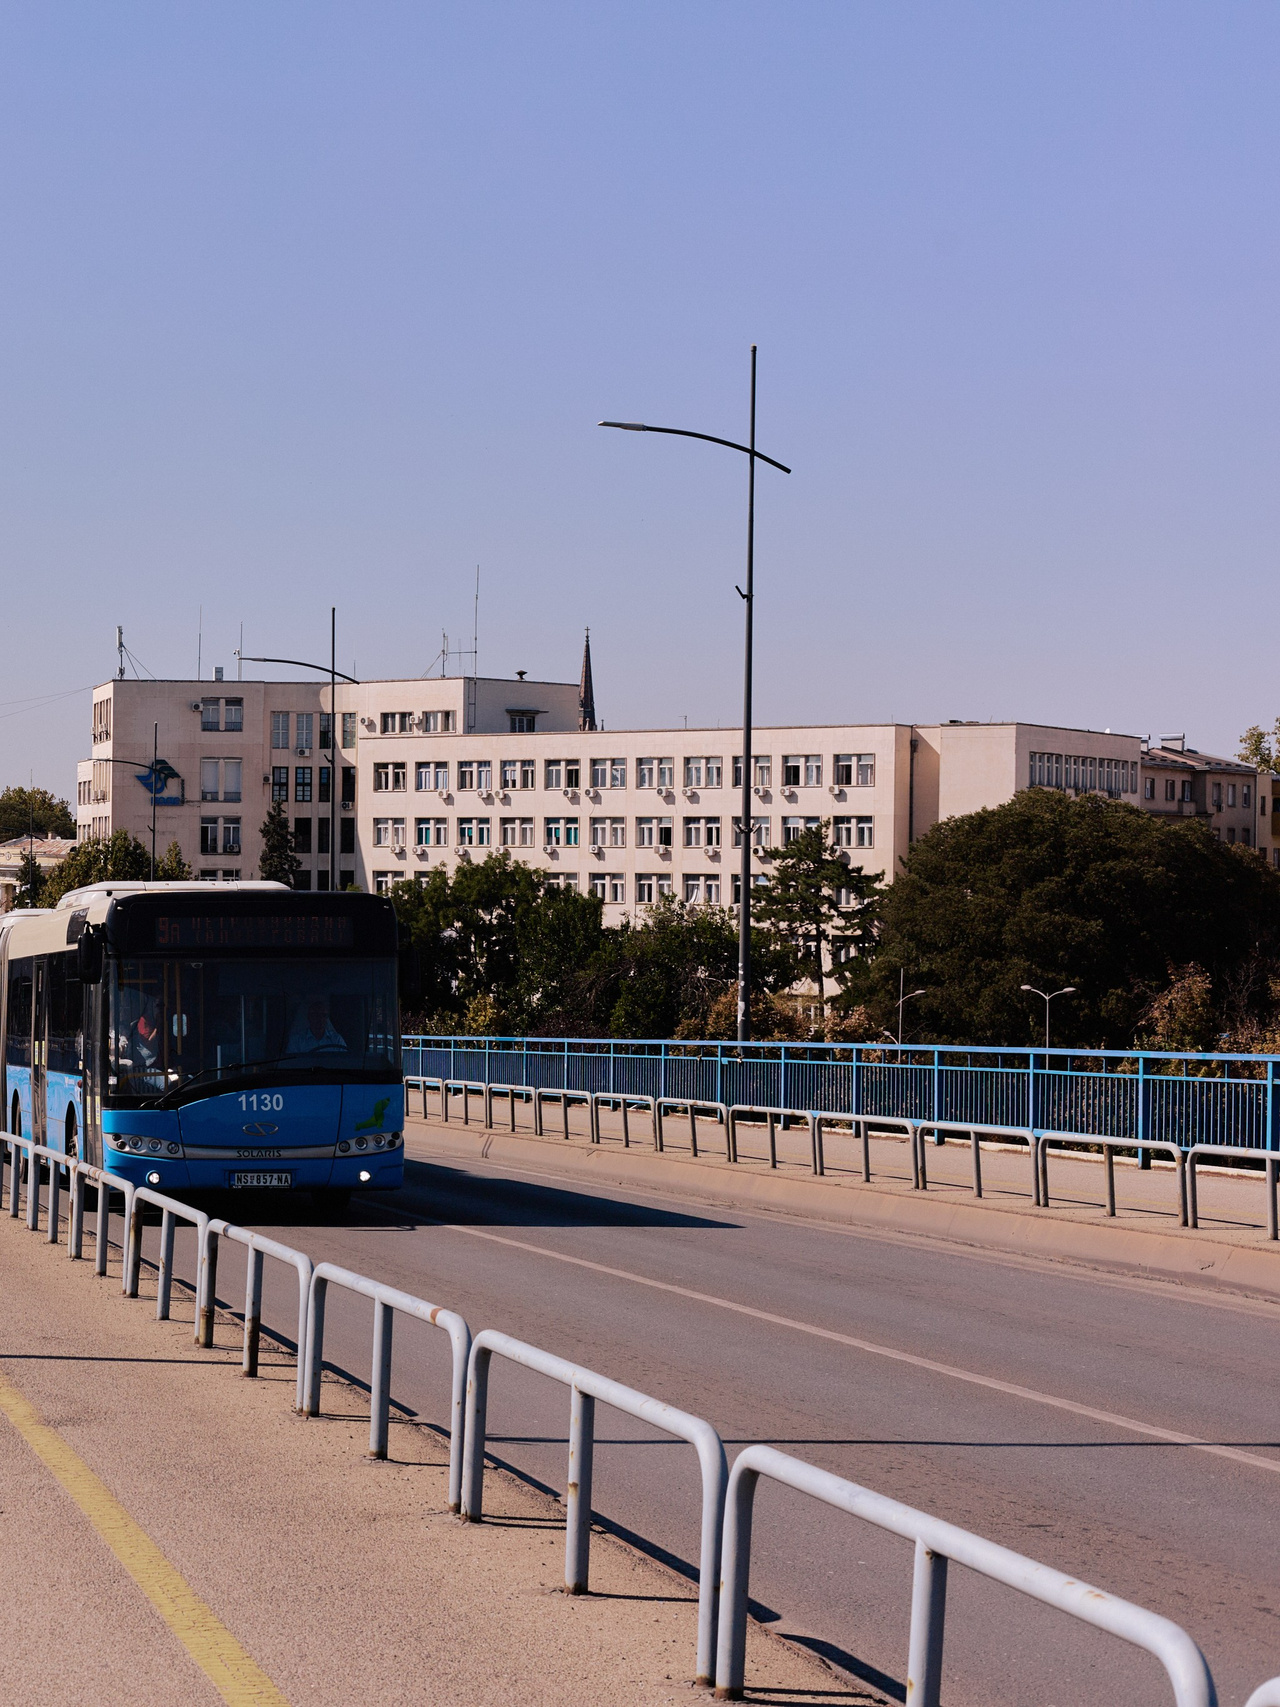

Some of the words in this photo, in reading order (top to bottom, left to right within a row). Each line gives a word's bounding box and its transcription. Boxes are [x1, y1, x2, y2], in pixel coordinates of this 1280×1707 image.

[238, 1094, 283, 1111] 1130
[237, 1150, 282, 1158] SOLARIS
[236, 1175, 248, 1184] NS
